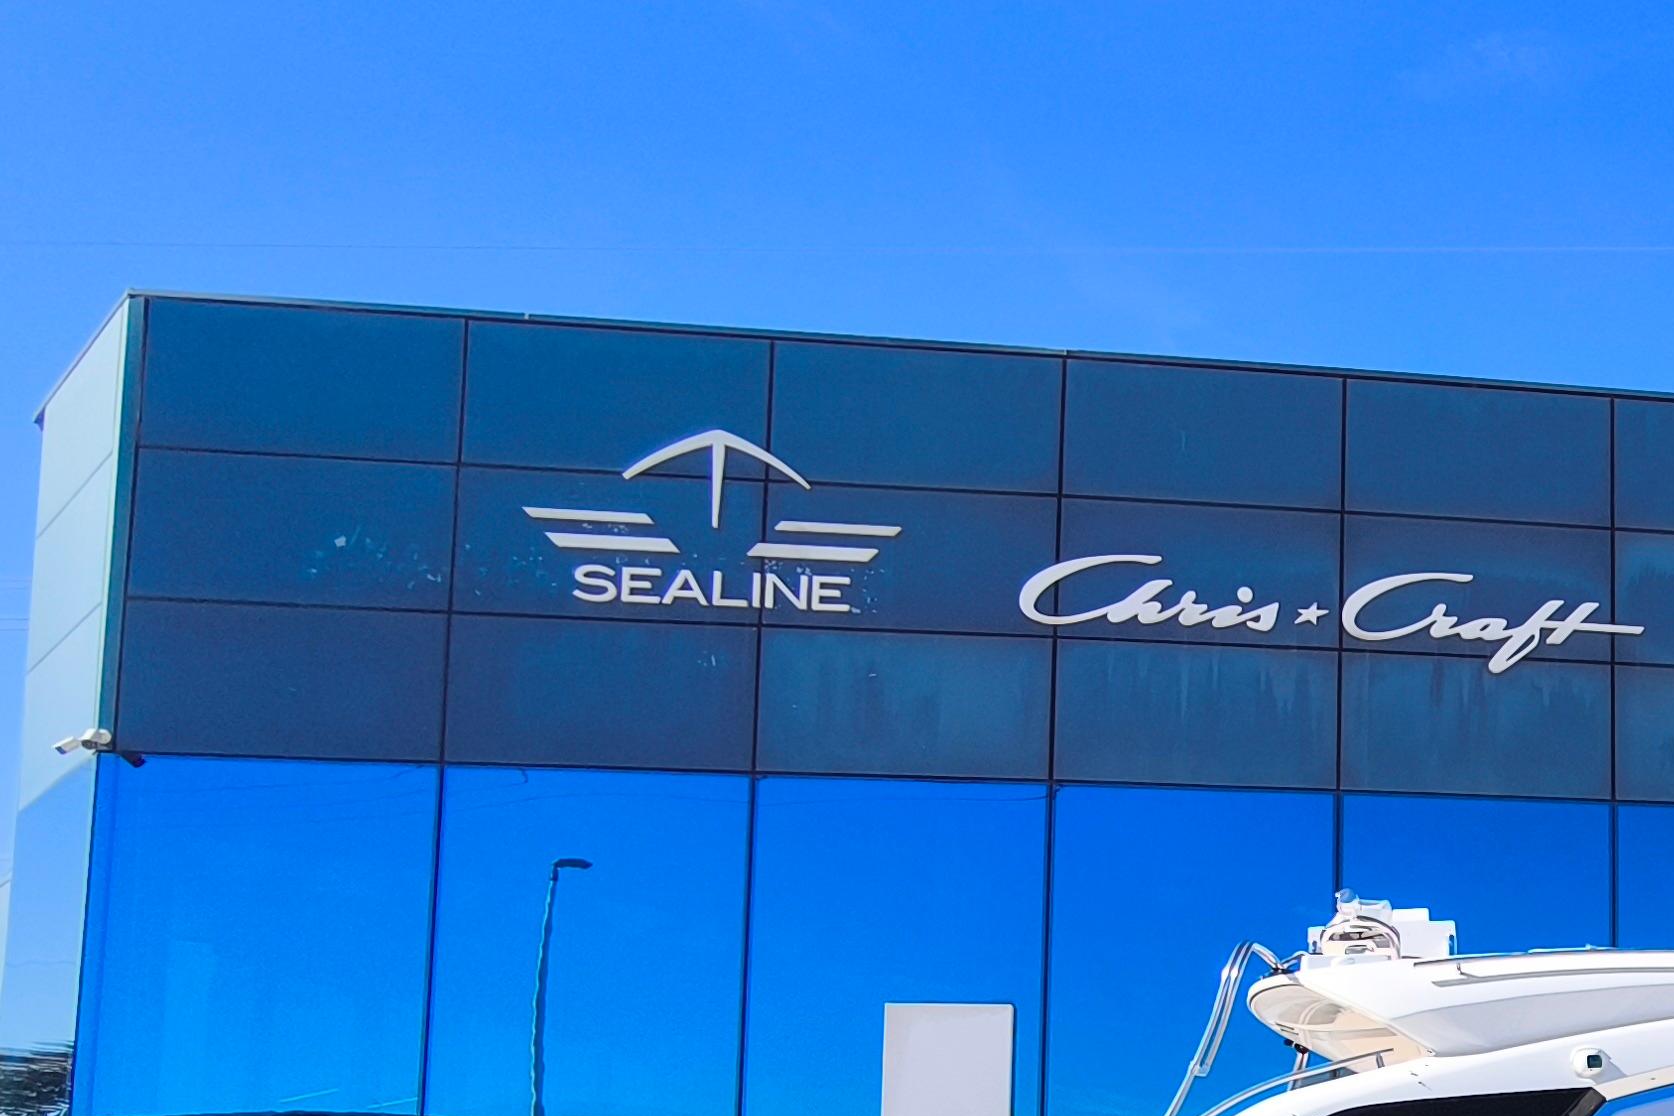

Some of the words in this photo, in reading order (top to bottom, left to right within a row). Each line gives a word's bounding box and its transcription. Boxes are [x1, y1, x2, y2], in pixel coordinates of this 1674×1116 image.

[572, 563, 852, 611] SEALINE
[1019, 554, 1280, 632] Chris
[1341, 572, 1645, 674] Craft
